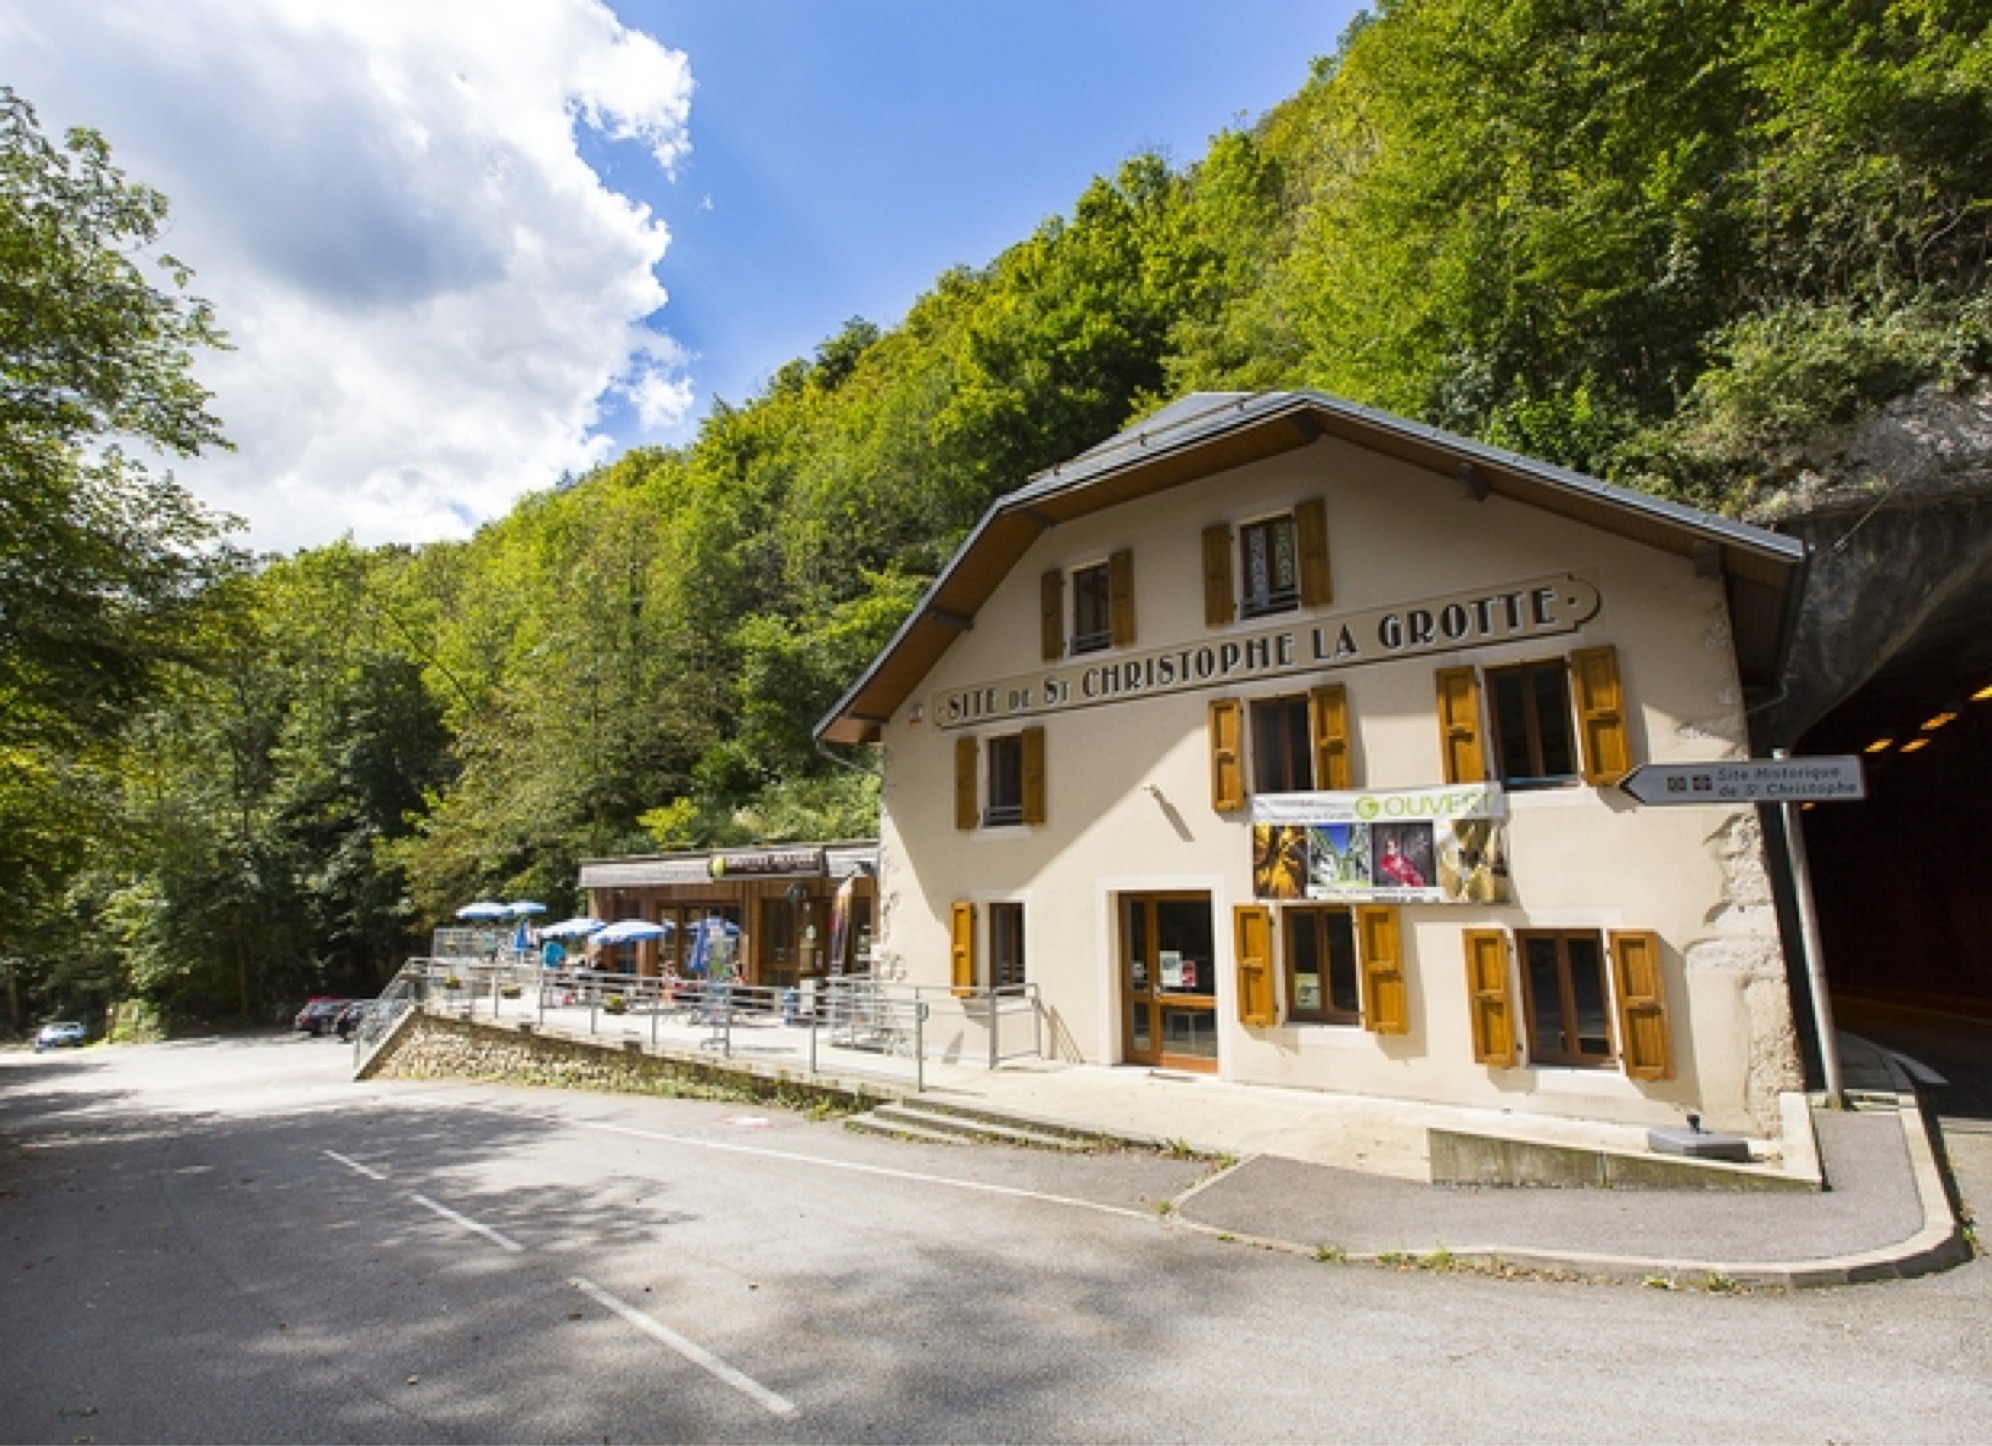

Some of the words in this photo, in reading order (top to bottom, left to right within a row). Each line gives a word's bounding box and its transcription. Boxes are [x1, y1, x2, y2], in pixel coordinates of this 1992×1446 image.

[948, 688, 997, 720] SITE
[1082, 633, 1295, 699] CHRISTOPHE
[1312, 624, 1357, 660] LA
[1377, 587, 1559, 650] GROTTE
[1717, 767, 1749, 782] Site
[1755, 766, 1841, 781] Historique
[1718, 784, 1737, 798] de
[1766, 782, 1857, 796] Christophe
